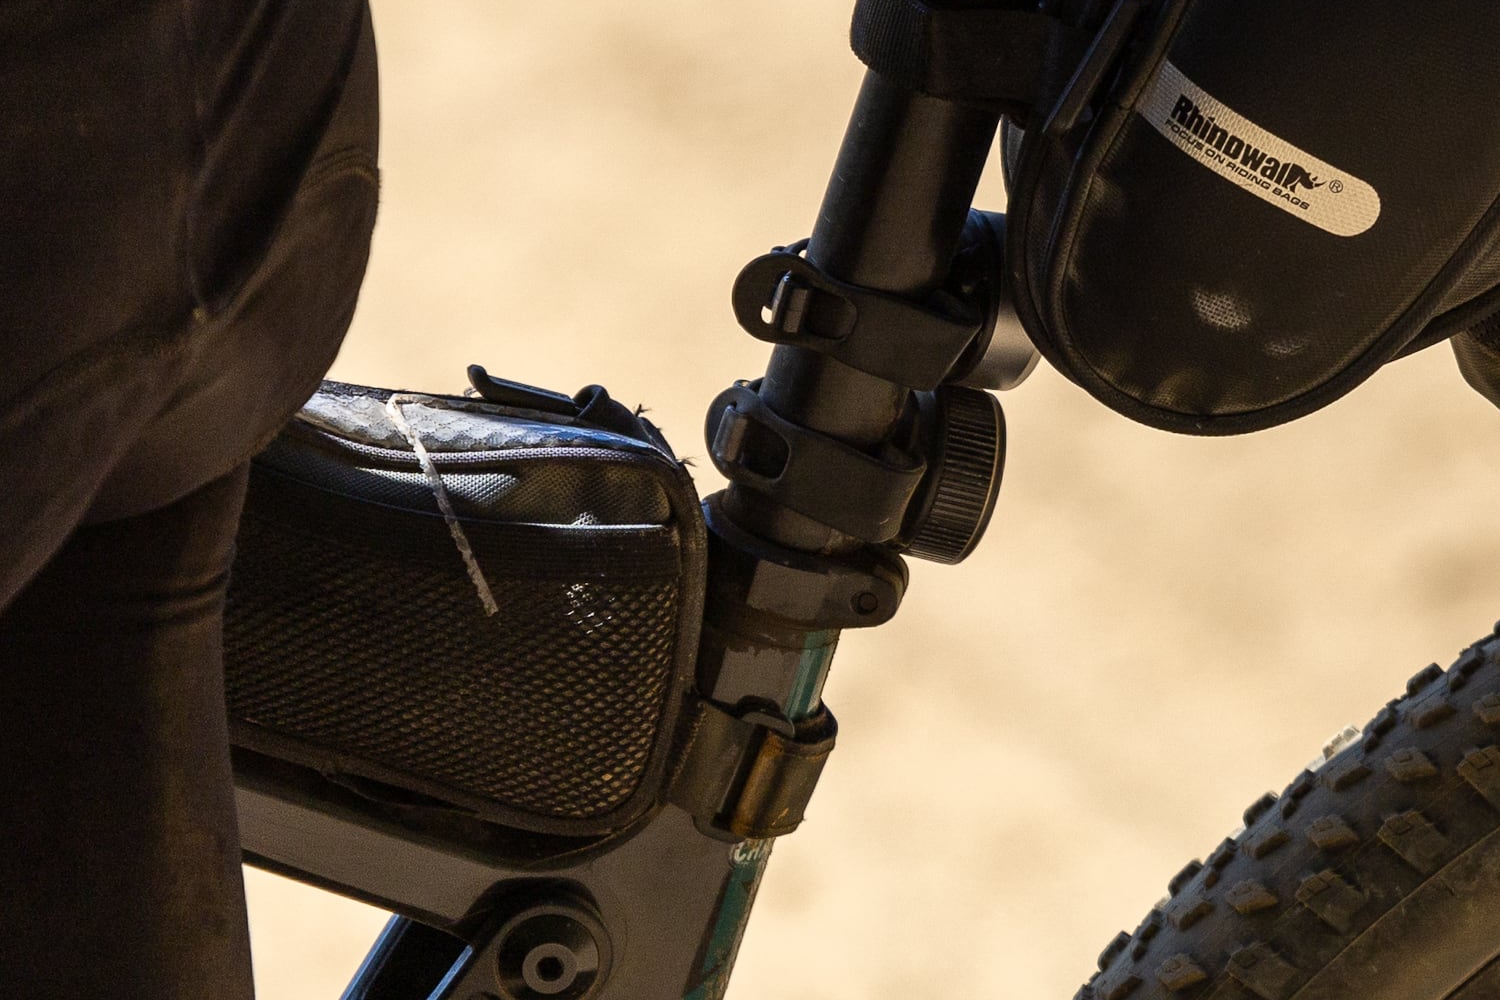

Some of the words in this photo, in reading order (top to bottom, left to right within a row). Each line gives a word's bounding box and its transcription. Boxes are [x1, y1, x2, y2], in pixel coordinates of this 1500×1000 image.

[1165, 118, 1205, 151] FOCUS
[1204, 147, 1227, 165] ON
[1226, 160, 1271, 190] RIDING
[1271, 187, 1311, 211] BAGS
